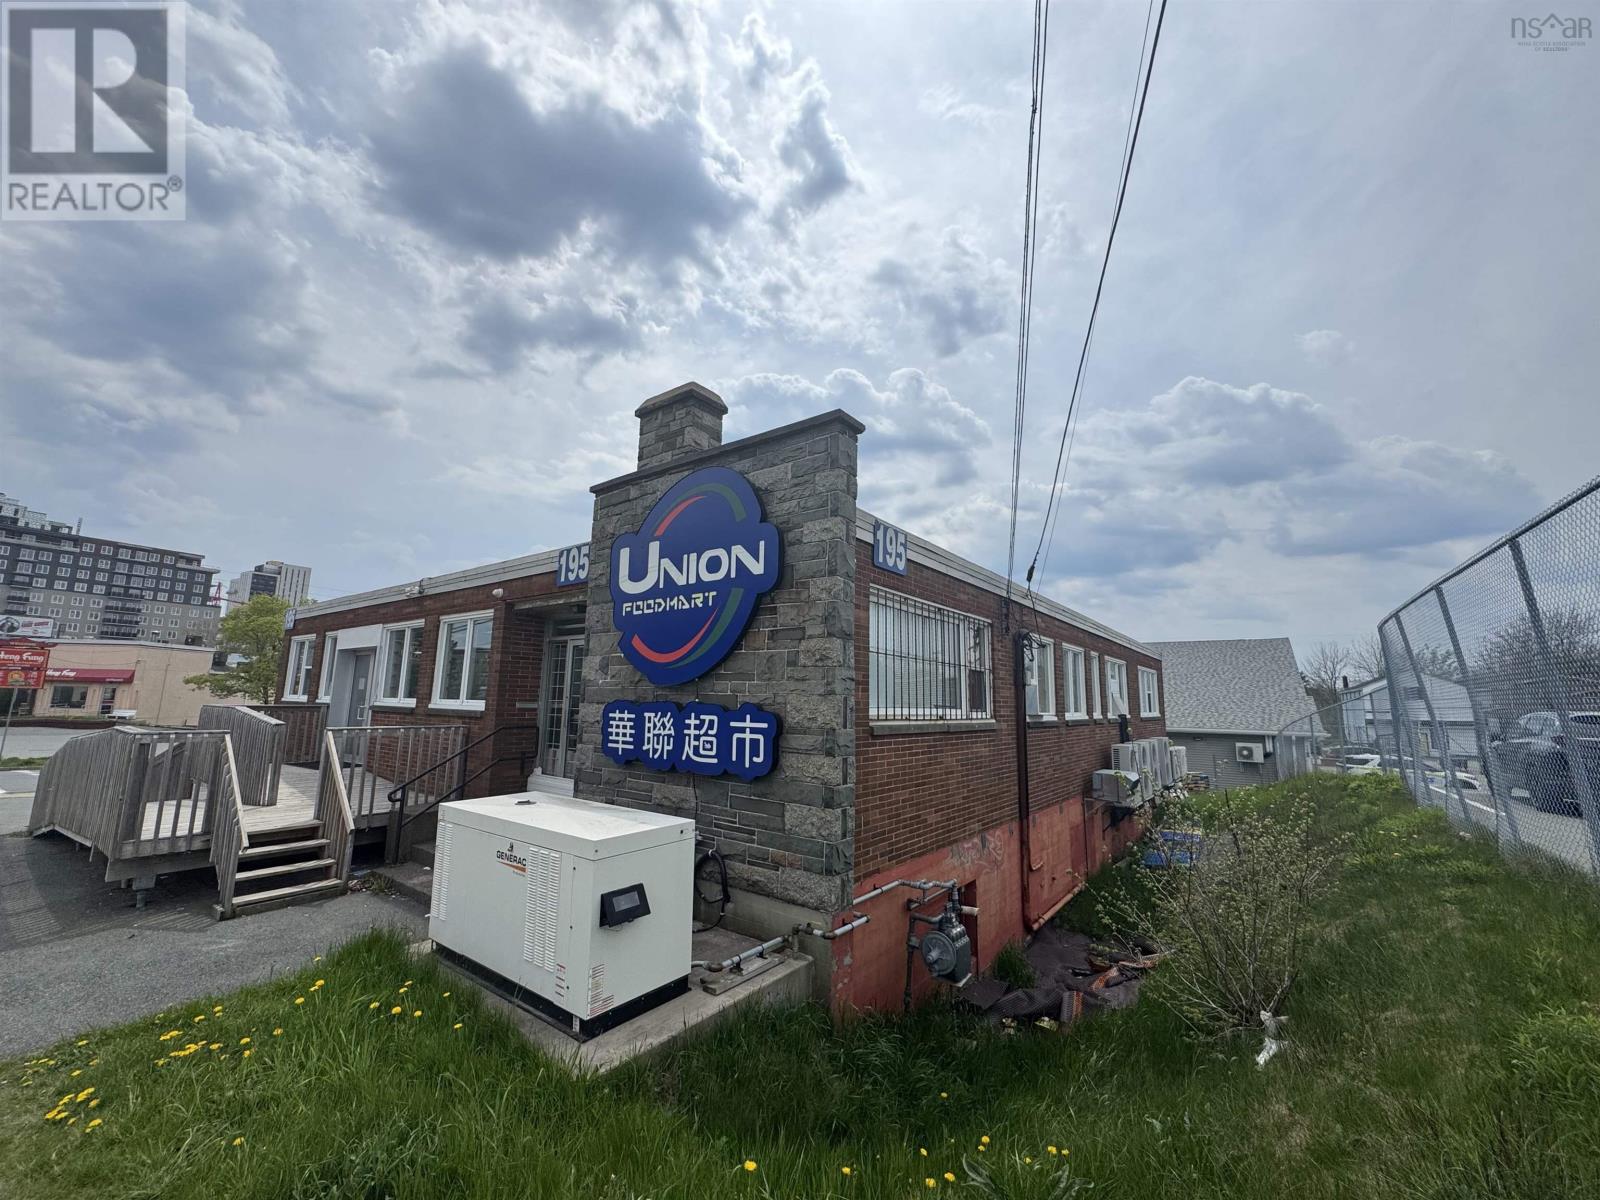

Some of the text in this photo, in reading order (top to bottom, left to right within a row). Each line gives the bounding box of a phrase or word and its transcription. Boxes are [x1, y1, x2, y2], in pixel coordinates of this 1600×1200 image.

[559, 545, 589, 583] 195
[619, 540, 765, 594] UNION
[876, 523, 907, 570] 195
[622, 592, 717, 616] FOODMART
[607, 709, 768, 769] 華聯超市
[496, 850, 527, 866] GENERAC
